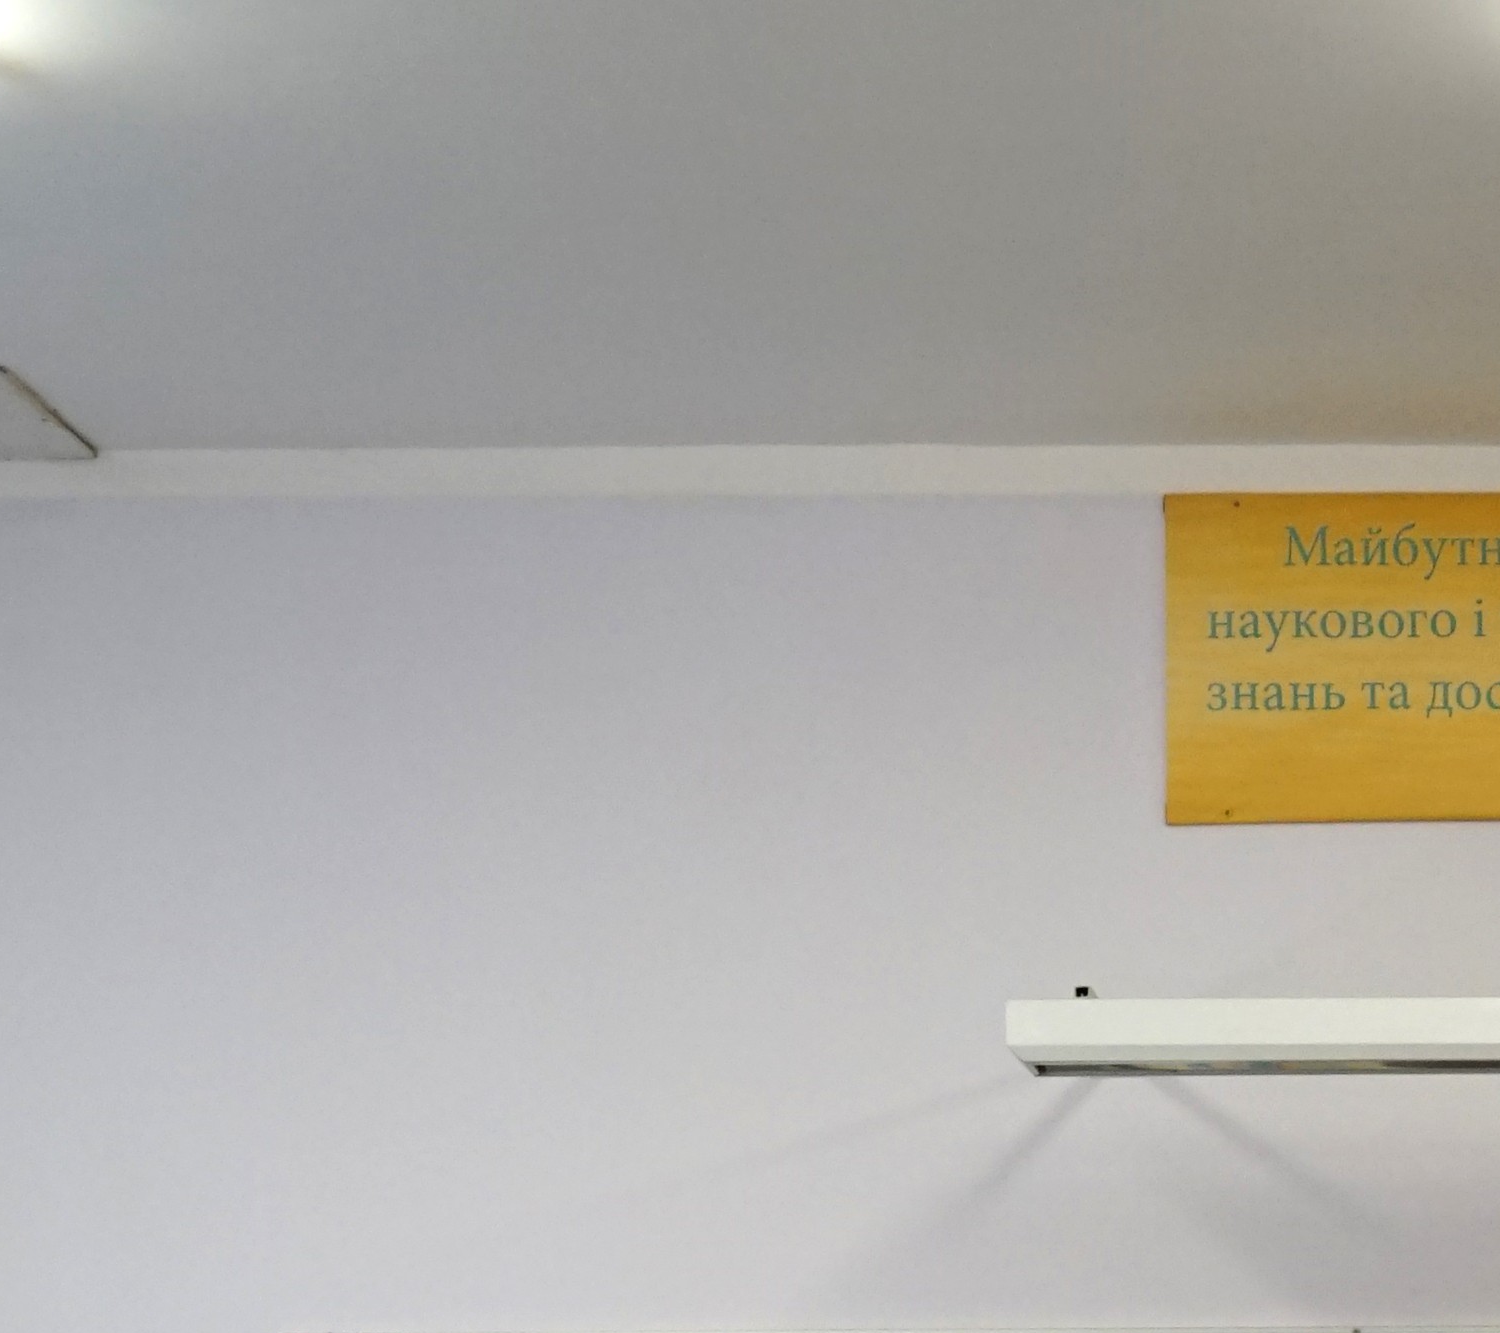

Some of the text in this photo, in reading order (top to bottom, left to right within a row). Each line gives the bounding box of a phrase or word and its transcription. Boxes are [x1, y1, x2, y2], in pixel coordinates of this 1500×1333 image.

[1207, 608, 1457, 653] наукового
[1473, 599, 1486, 638] і
[1207, 680, 1345, 711] знань
[1361, 680, 1409, 710] та
